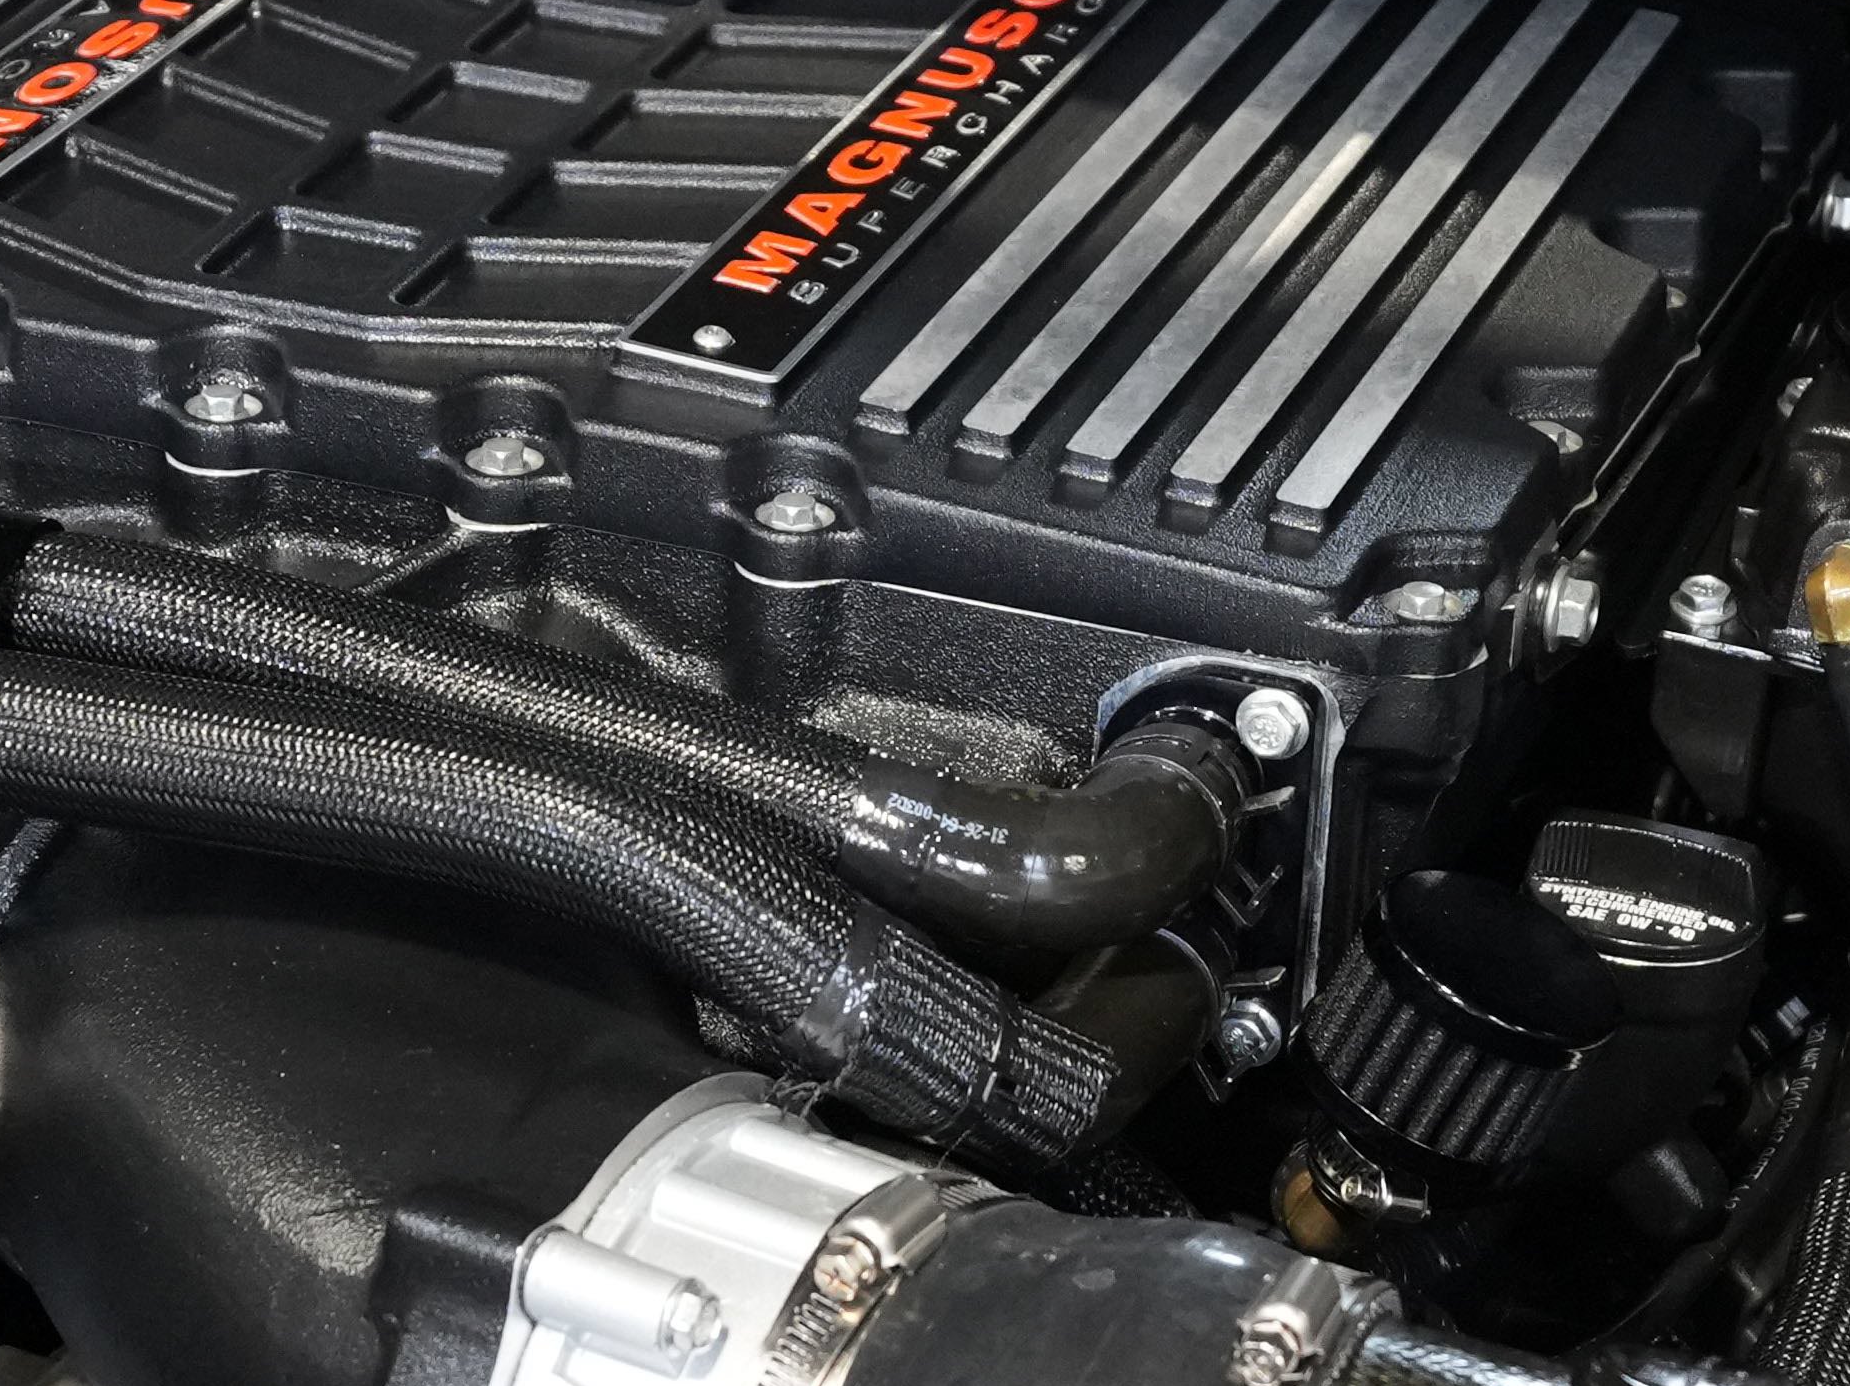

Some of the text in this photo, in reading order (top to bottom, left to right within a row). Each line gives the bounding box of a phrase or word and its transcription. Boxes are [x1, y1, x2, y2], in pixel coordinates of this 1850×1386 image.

[1539, 882, 1738, 933] SYNTHETIC ENGINE OIL
[1560, 892, 1708, 932] RECOMMENDED
[1565, 904, 1609, 923] SAE
